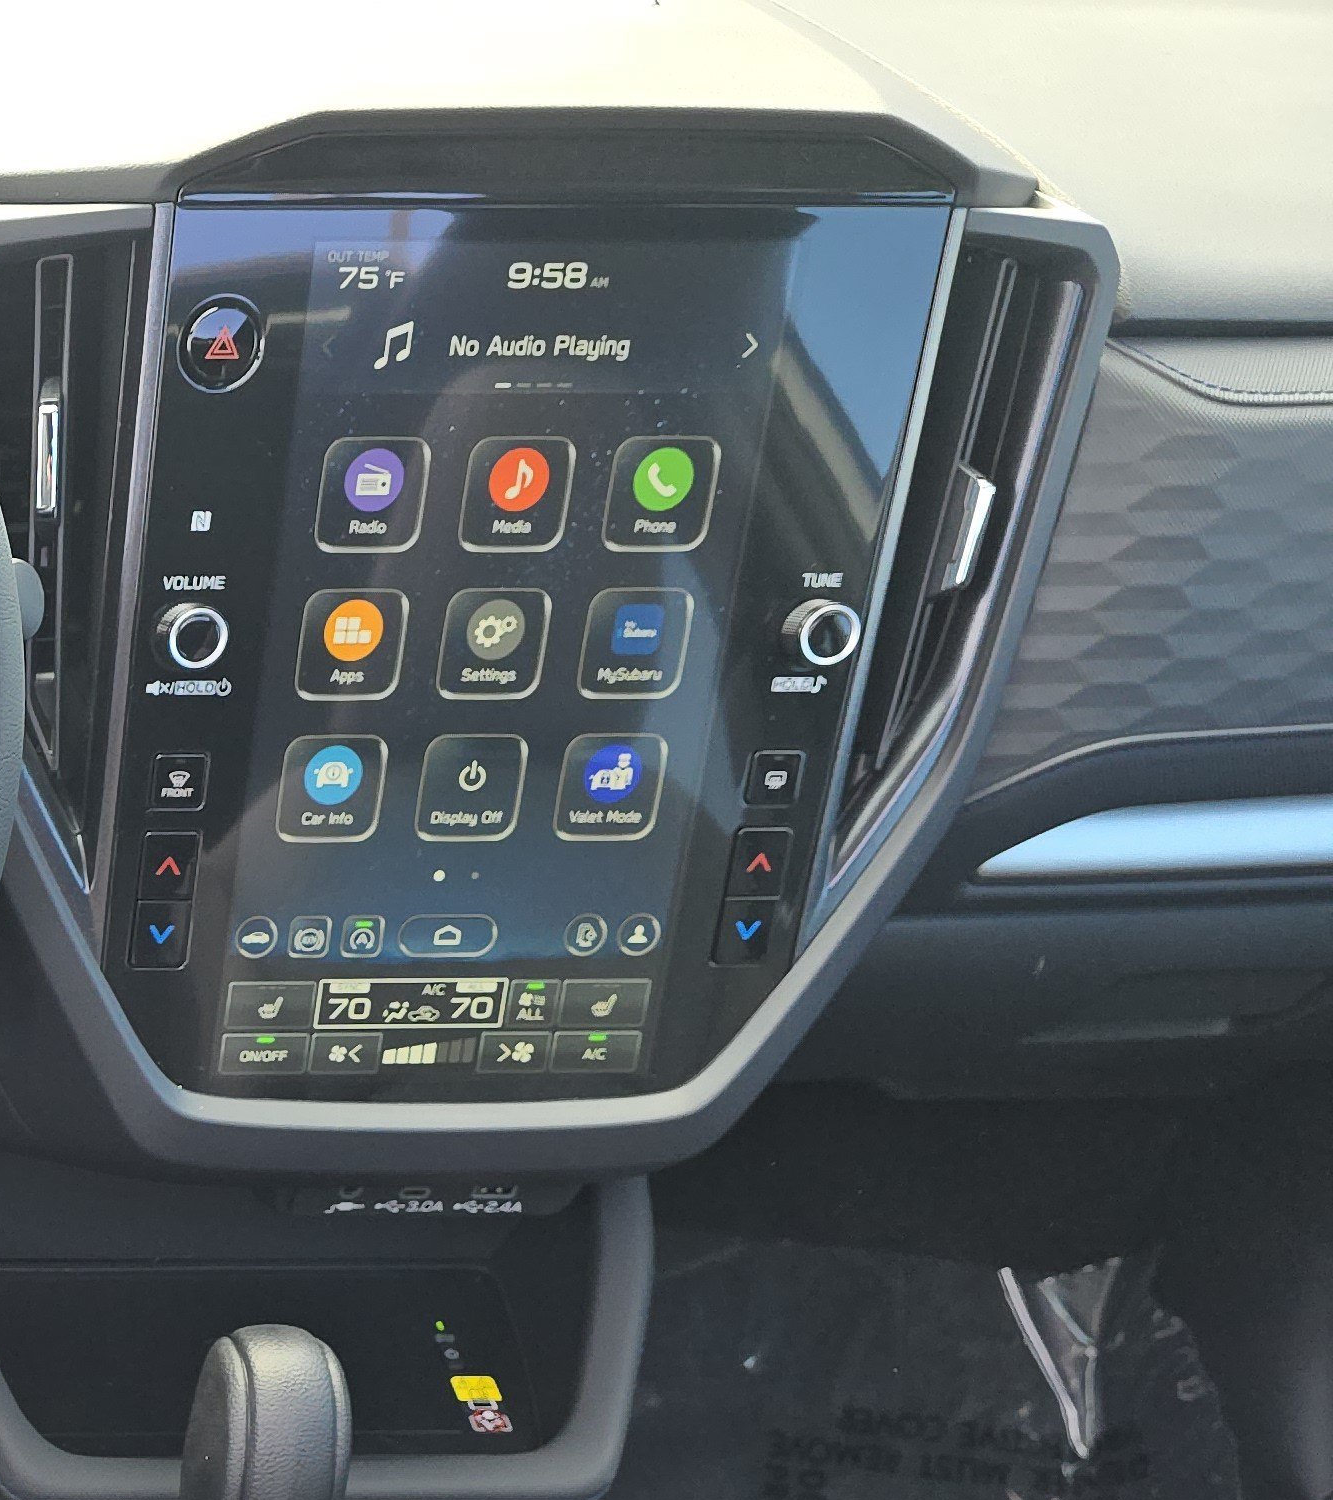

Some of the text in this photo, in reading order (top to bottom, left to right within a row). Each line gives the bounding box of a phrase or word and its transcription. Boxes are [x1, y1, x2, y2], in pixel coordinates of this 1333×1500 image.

[337, 266, 379, 290] 75
[507, 261, 589, 290] 9:58
[449, 334, 631, 362] No Audio Playing
[348, 518, 387, 536] Radio
[491, 518, 532, 535] Media
[633, 518, 676, 536] Phone
[162, 575, 227, 591] VOLUME
[801, 572, 844, 589] TUNE
[330, 667, 365, 685] Apps
[460, 667, 517, 685] Settings
[596, 667, 662, 684] MySubaru
[174, 681, 216, 696] HOLD
[160, 787, 194, 799] FRONT
[301, 811, 354, 827] Car Info
[431, 810, 504, 828] Display Off
[568, 810, 643, 825] Valet Mode
[420, 983, 447, 996] A/C
[328, 997, 372, 1020] 70
[450, 996, 494, 1019] 70
[515, 1007, 545, 1021] ALL
[239, 1050, 289, 1063] ON/OFF
[581, 1047, 608, 1061] A/C
